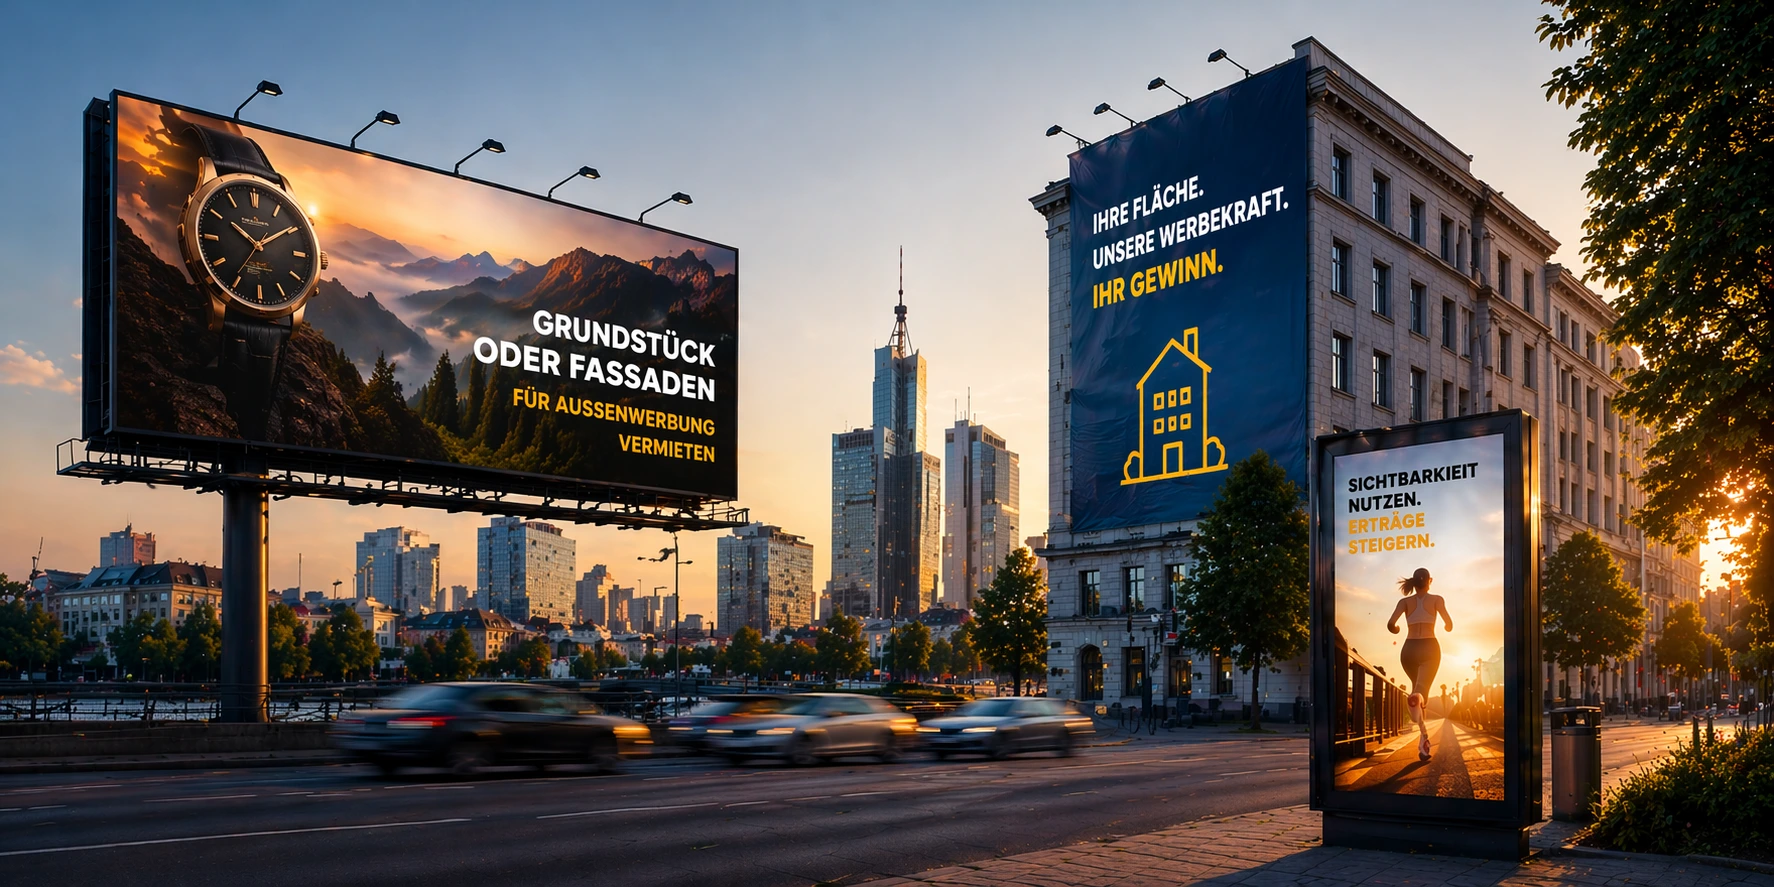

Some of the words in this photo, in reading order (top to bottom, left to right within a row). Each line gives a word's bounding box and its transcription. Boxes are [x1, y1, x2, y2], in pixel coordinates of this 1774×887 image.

[1093, 201, 1129, 235] IHRE
[1133, 175, 1204, 220] FLÄCHE.
[1093, 229, 1155, 270] UNSERE
[1159, 185, 1289, 248] WERBEKRAFT.
[1093, 276, 1125, 309] IHR
[1130, 248, 1224, 298] GEWINN.
[533, 309, 716, 367] GRUNDSTÜCK
[473, 336, 561, 376] ODER
[569, 353, 715, 402] FASSADEN
[513, 386, 550, 411] FÜR
[555, 395, 715, 436] AUSSENWERBUNG
[618, 433, 715, 463] VERMIETEN
[1348, 462, 1478, 492] SICHTBARKIEIT
[1349, 491, 1421, 513] NUTZEN.
[1348, 511, 1425, 535] ERTRÄGE
[1348, 533, 1435, 554] STEIGERN.
